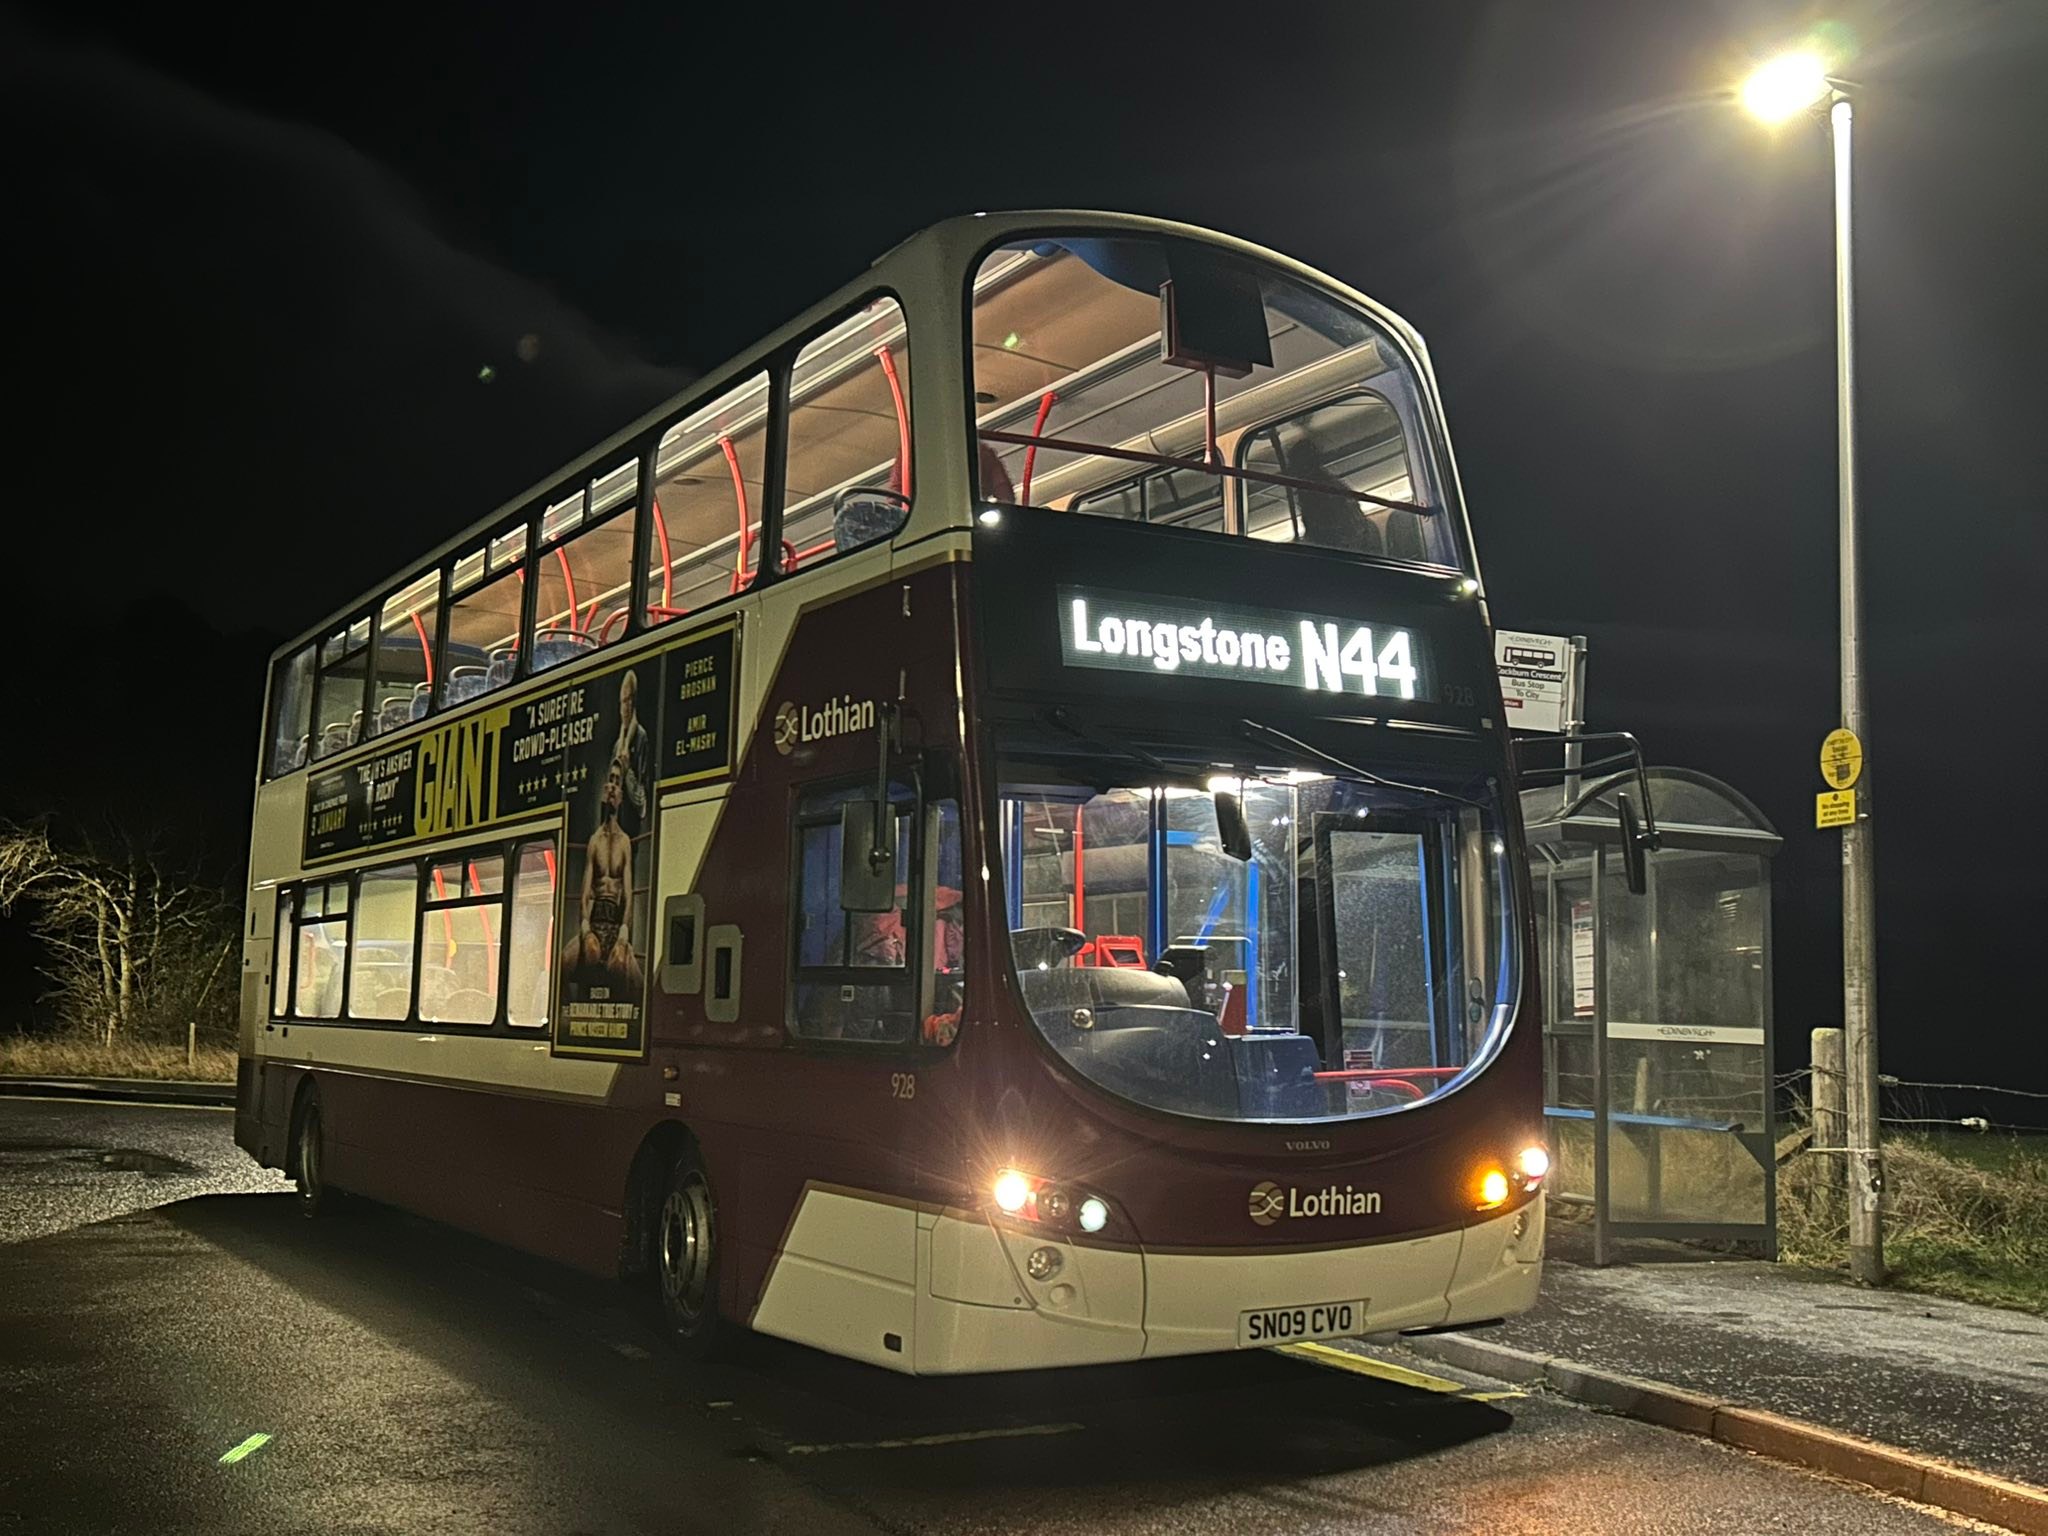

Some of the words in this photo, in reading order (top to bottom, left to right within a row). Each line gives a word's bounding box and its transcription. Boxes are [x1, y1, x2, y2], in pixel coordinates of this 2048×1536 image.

[1072, 599, 1291, 670] Longstone
[1300, 619, 1418, 699] N44
[685, 656, 714, 678] PIERCE
[1531, 670, 1562, 680] Crescent
[681, 675, 717, 700] BROSNAN
[1512, 679, 1526, 687] Bus
[1528, 681, 1545, 690] Stop
[1516, 689, 1525, 697] To
[1526, 691, 1540, 699] City
[538, 689, 585, 726] SUREFRE
[802, 694, 874, 742] Lothian
[513, 713, 599, 763] CROWD-PLEASER"
[676, 732, 717, 756] EL-MASRY
[386, 749, 413, 776] ANSWER
[414, 705, 511, 837] GIANT
[891, 1073, 915, 1099] 928
[1285, 1140, 1330, 1151] VOLVO
[1290, 1185, 1381, 1217] Lothian
[1249, 1310, 1306, 1340] SN09
[1311, 1305, 1351, 1334] CVO
